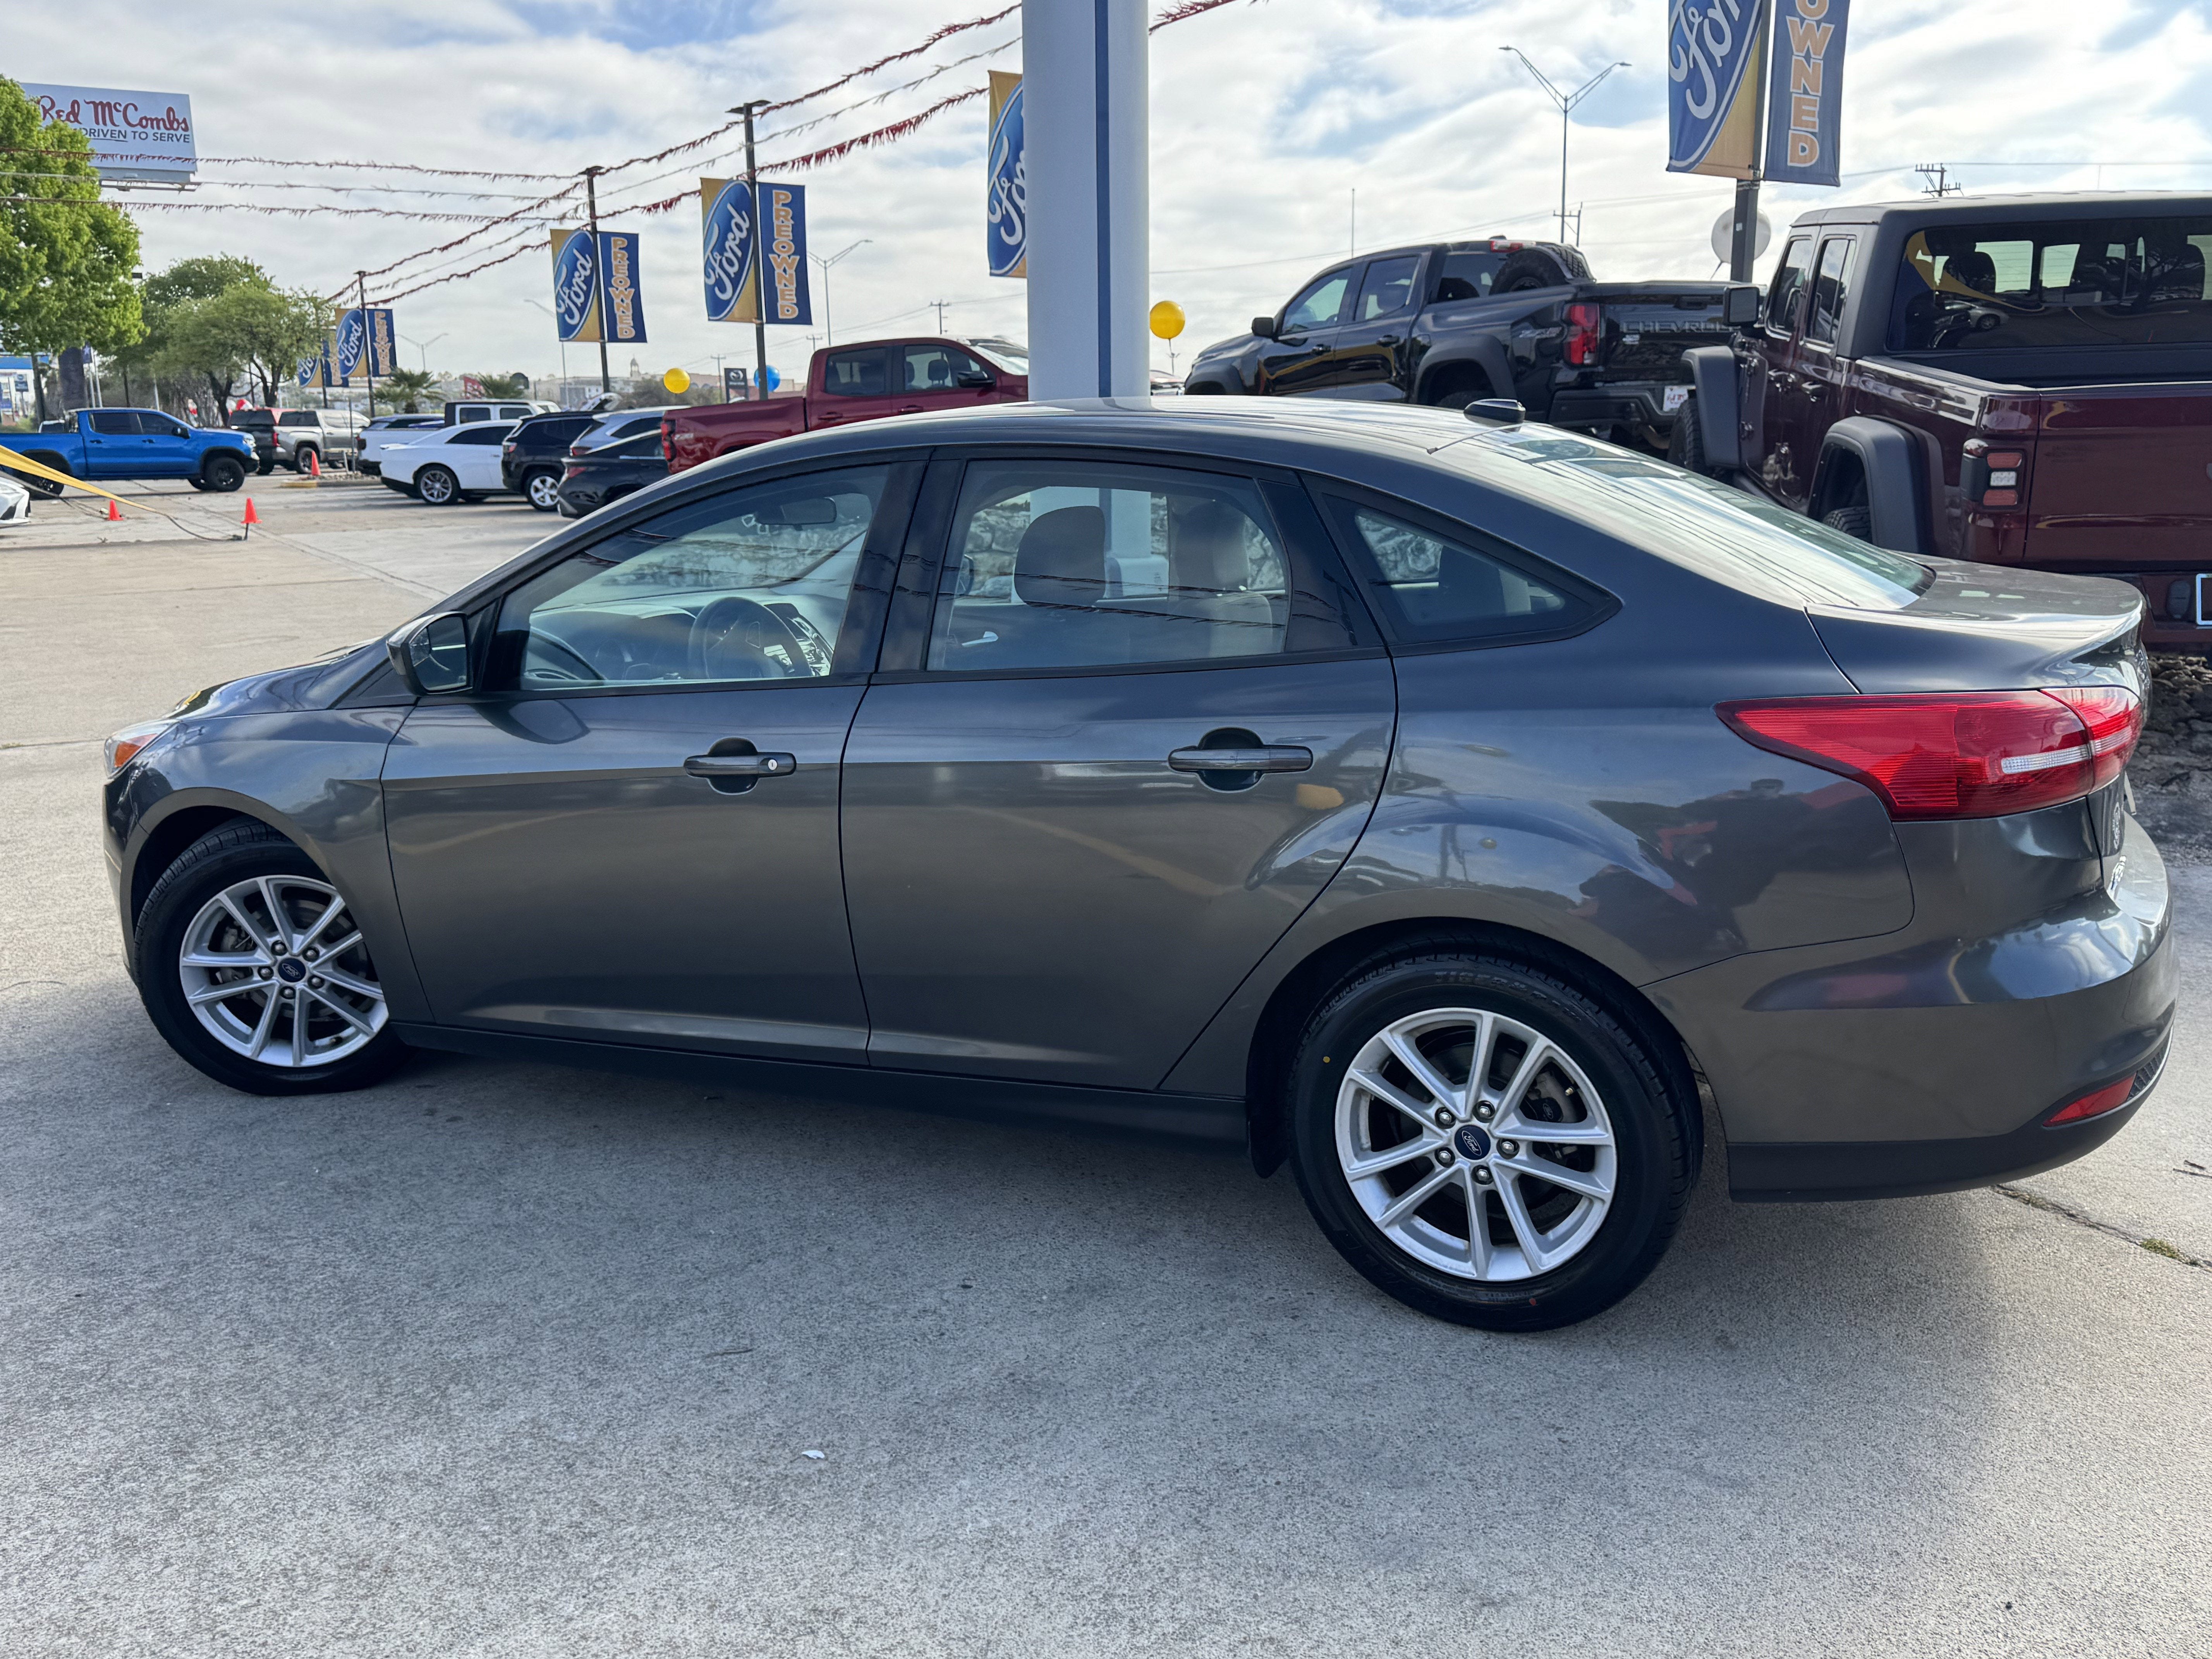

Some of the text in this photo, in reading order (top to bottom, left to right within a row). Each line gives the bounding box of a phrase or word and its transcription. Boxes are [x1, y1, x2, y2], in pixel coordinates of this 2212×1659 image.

[38, 95, 189, 132] Red McCombs
[131, 131, 148, 140] TO
[153, 132, 190, 143] SERVE
[704, 203, 750, 300] Ford
[768, 190, 800, 319] PREOWNED
[556, 248, 593, 325] Ford
[608, 237, 635, 338] PREOWNED
[338, 319, 362, 367] Ford
[1464, 1135, 1479, 1152] Ford
